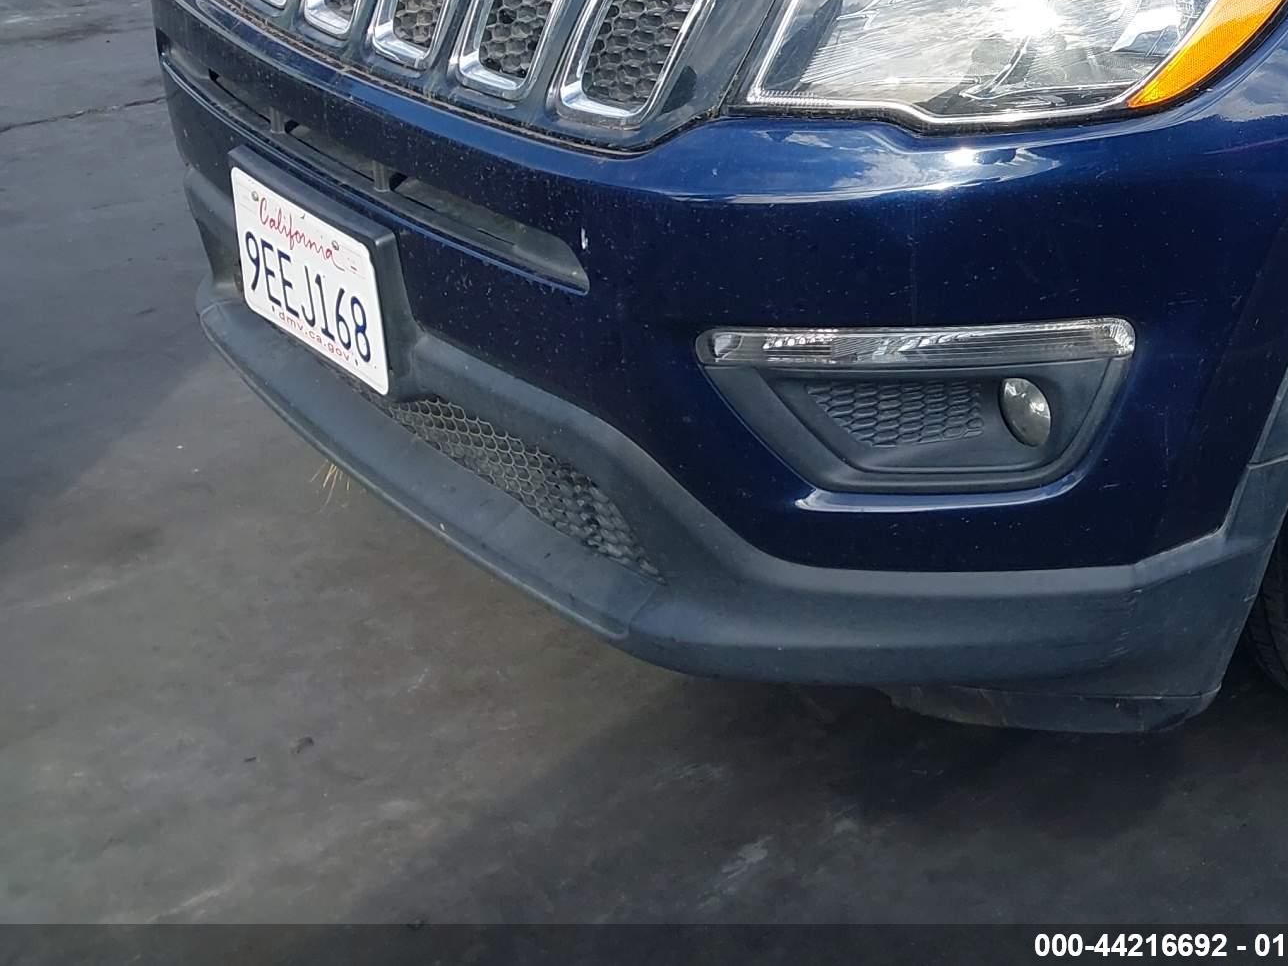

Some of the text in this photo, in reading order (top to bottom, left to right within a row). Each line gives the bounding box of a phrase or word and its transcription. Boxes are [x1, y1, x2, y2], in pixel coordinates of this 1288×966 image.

[259, 197, 346, 272] California
[245, 231, 371, 363] 9EEJ168
[279, 311, 350, 361] dmv.ca.gov
